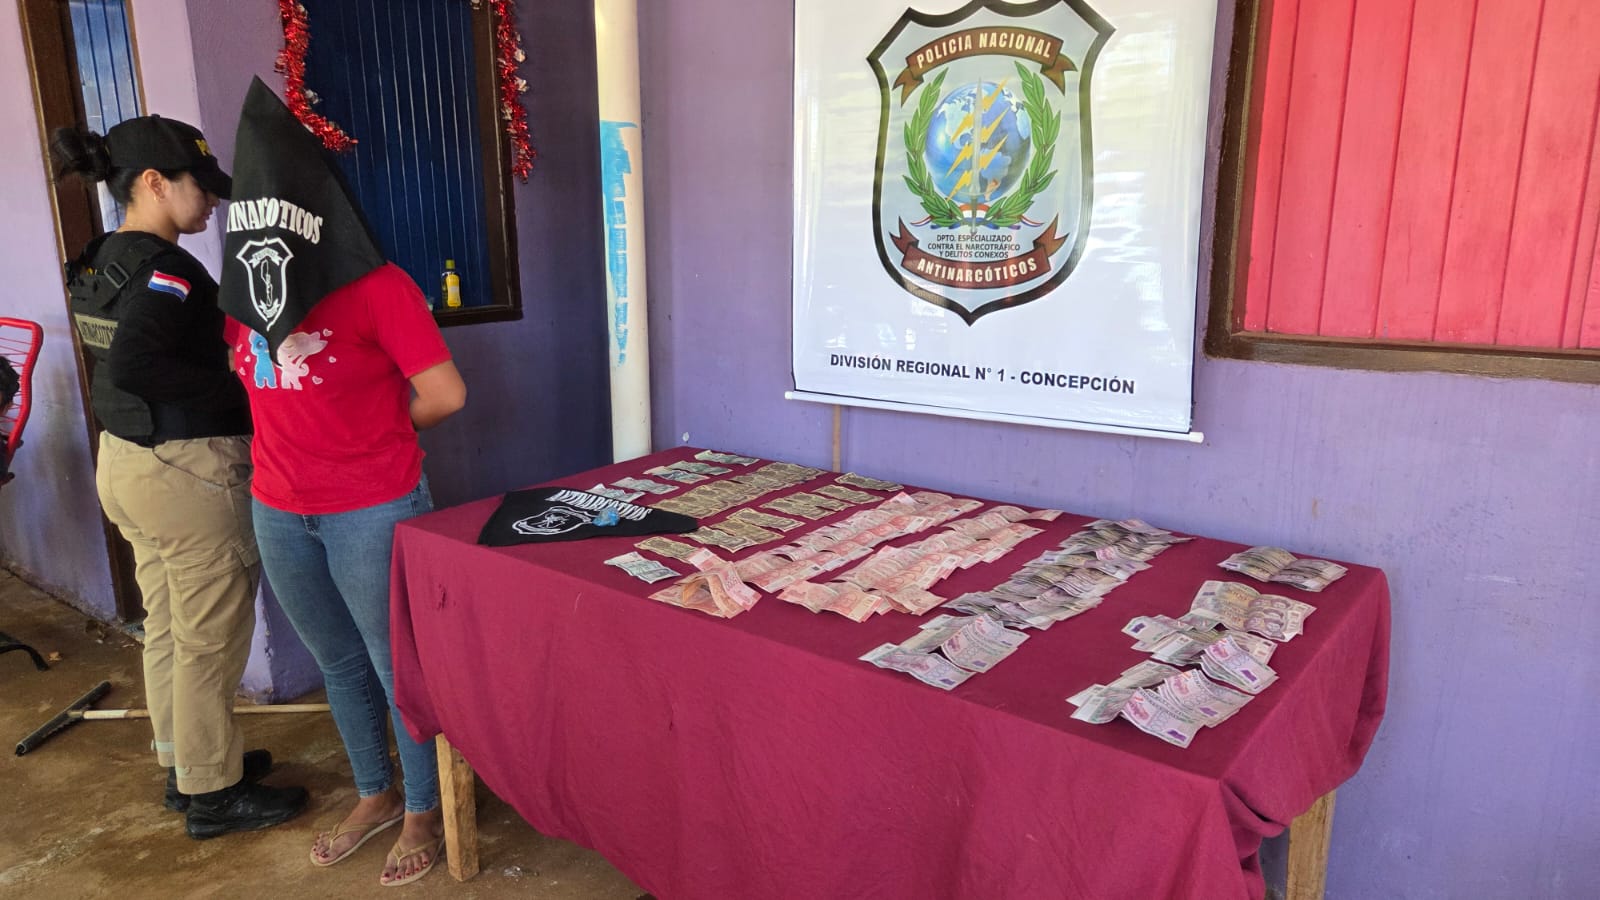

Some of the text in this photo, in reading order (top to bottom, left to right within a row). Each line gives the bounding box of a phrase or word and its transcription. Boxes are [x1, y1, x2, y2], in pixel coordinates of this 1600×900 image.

[916, 31, 1052, 69] POLICIA NACIONAL
[927, 242, 1021, 252] CONTRA EL NARCOTRÁFICO
[936, 234, 1013, 243] DPTO. ESPECIALIZADO
[944, 251, 973, 259] DELITOS
[974, 251, 1009, 259] CONEXOS
[917, 258, 1037, 282] ANTINARCÓTICOS
[830, 354, 892, 371] DIVISIÓN
[896, 359, 970, 379] REGIONAL
[997, 368, 1005, 382] 1
[1020, 371, 1135, 394] CONCEPCIÓN
